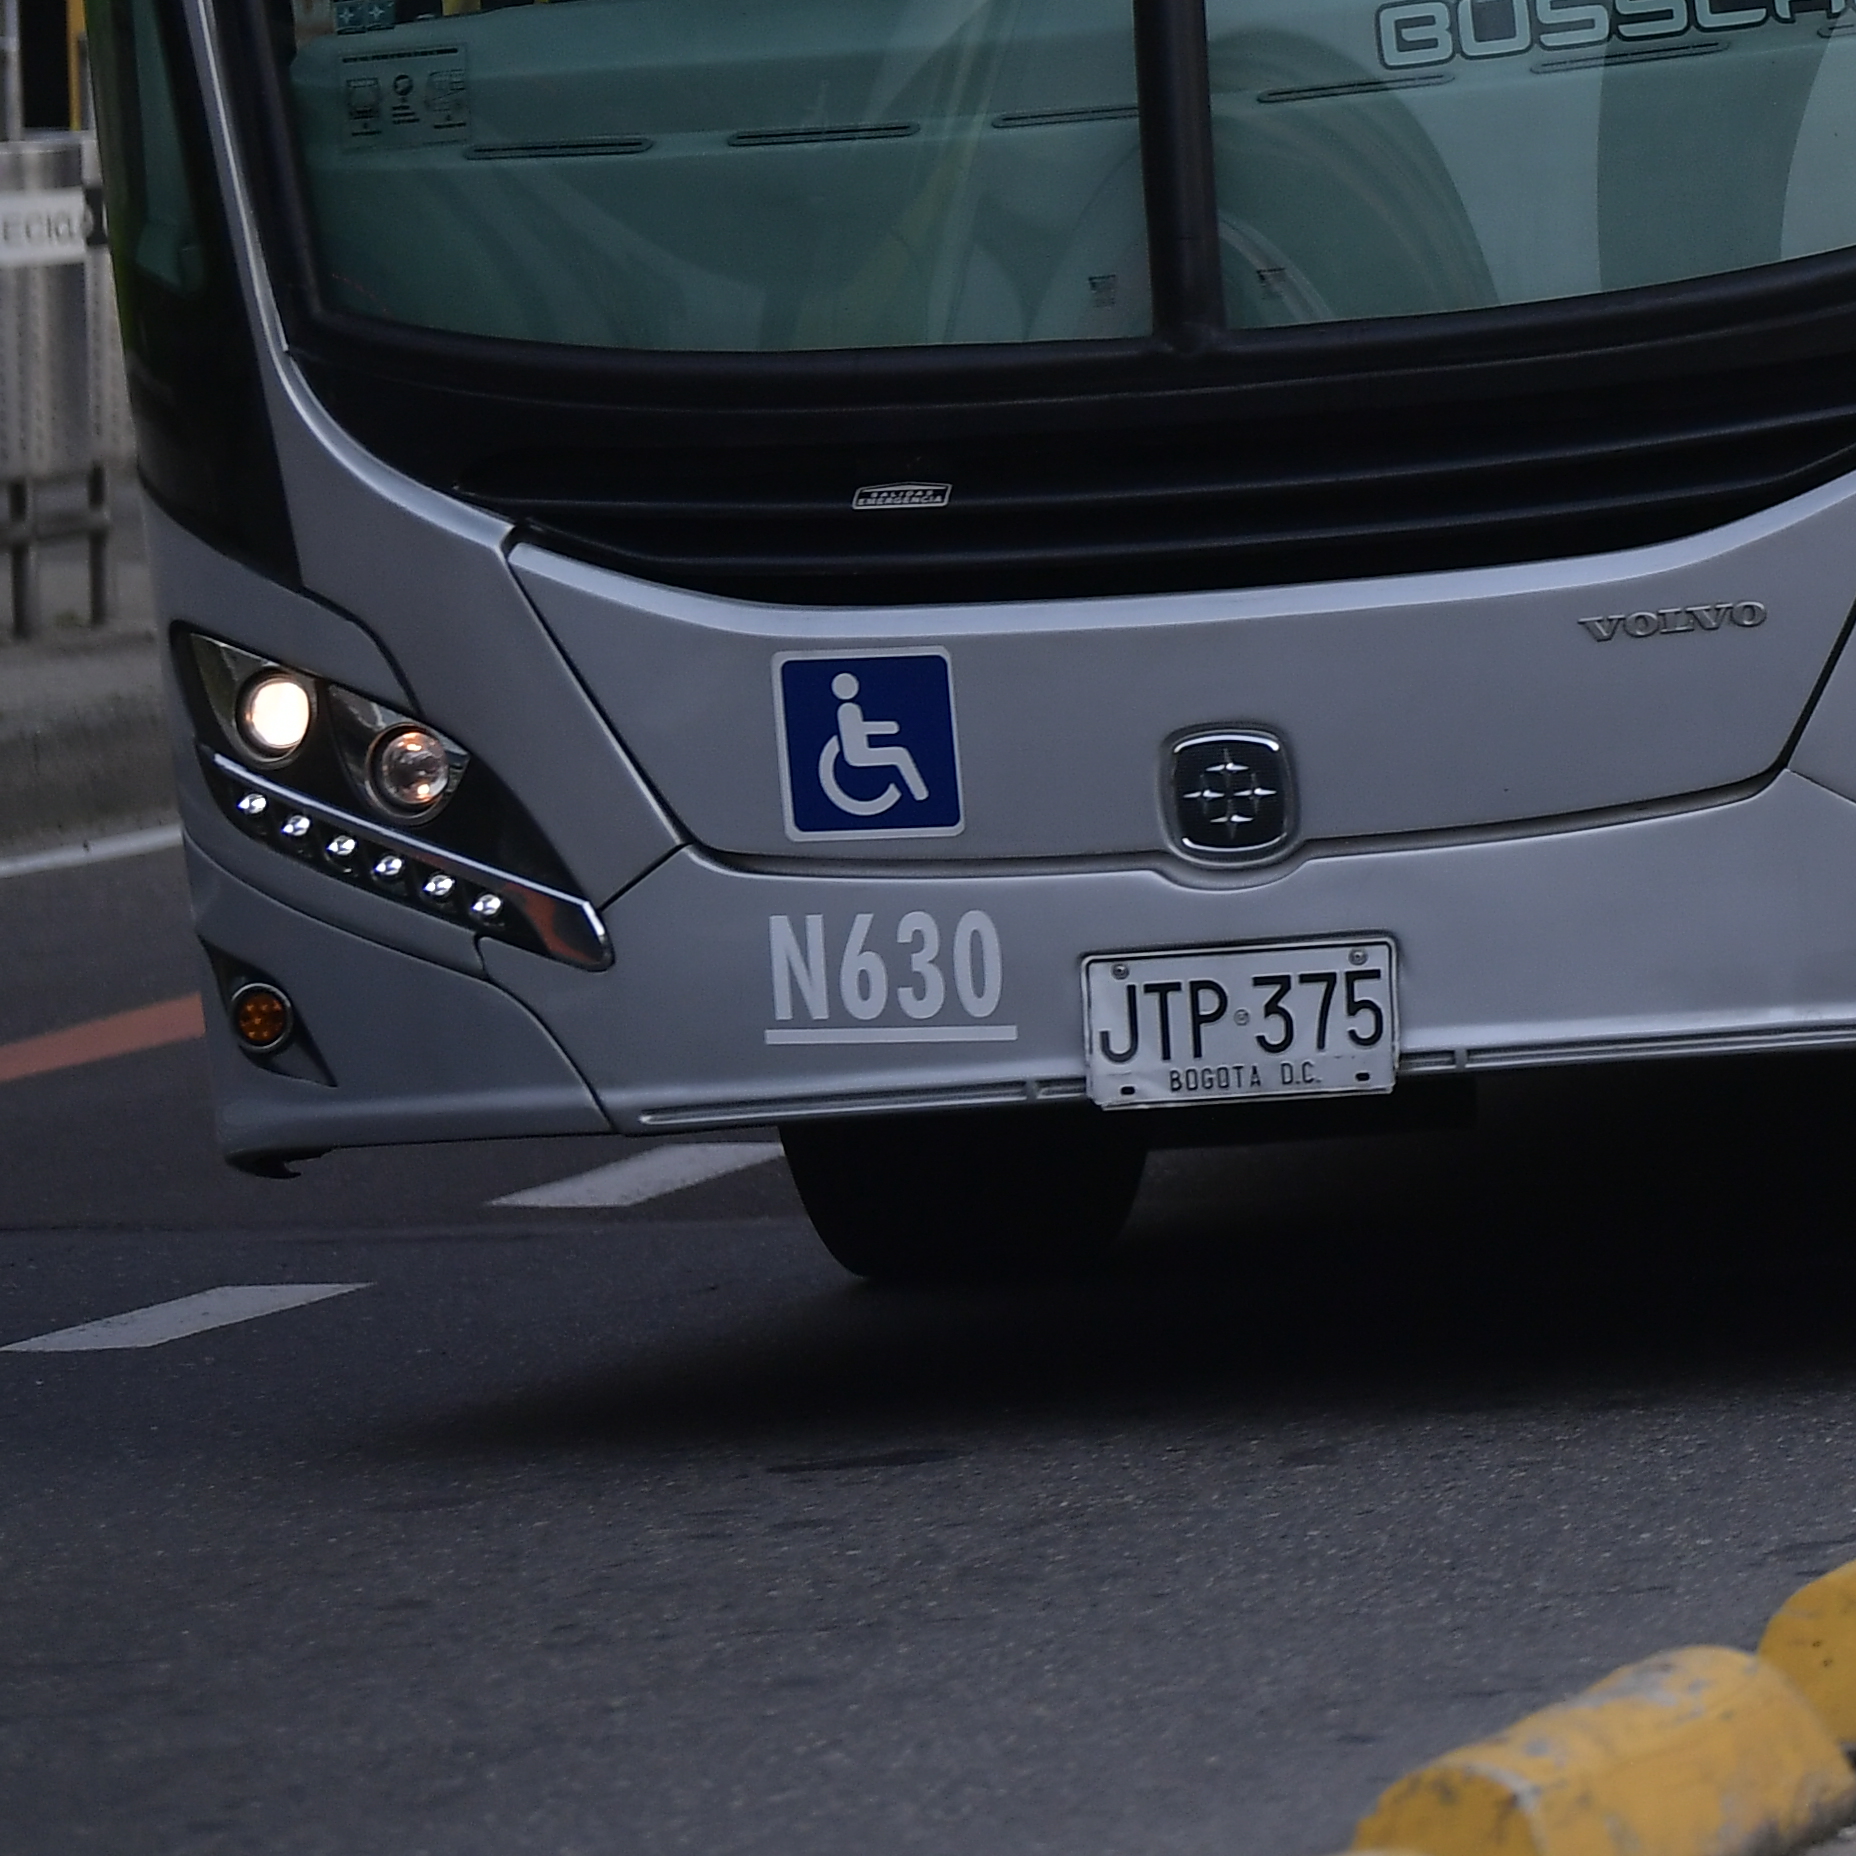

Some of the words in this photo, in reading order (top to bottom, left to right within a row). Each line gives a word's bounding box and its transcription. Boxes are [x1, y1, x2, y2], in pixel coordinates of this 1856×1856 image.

[1577, 600, 1768, 642] VOLVO
[769, 909, 1002, 1021] N630
[1100, 983, 1229, 1063] JTP
[1252, 968, 1384, 1055] 375
[1169, 1065, 1262, 1092] BOGOTA
